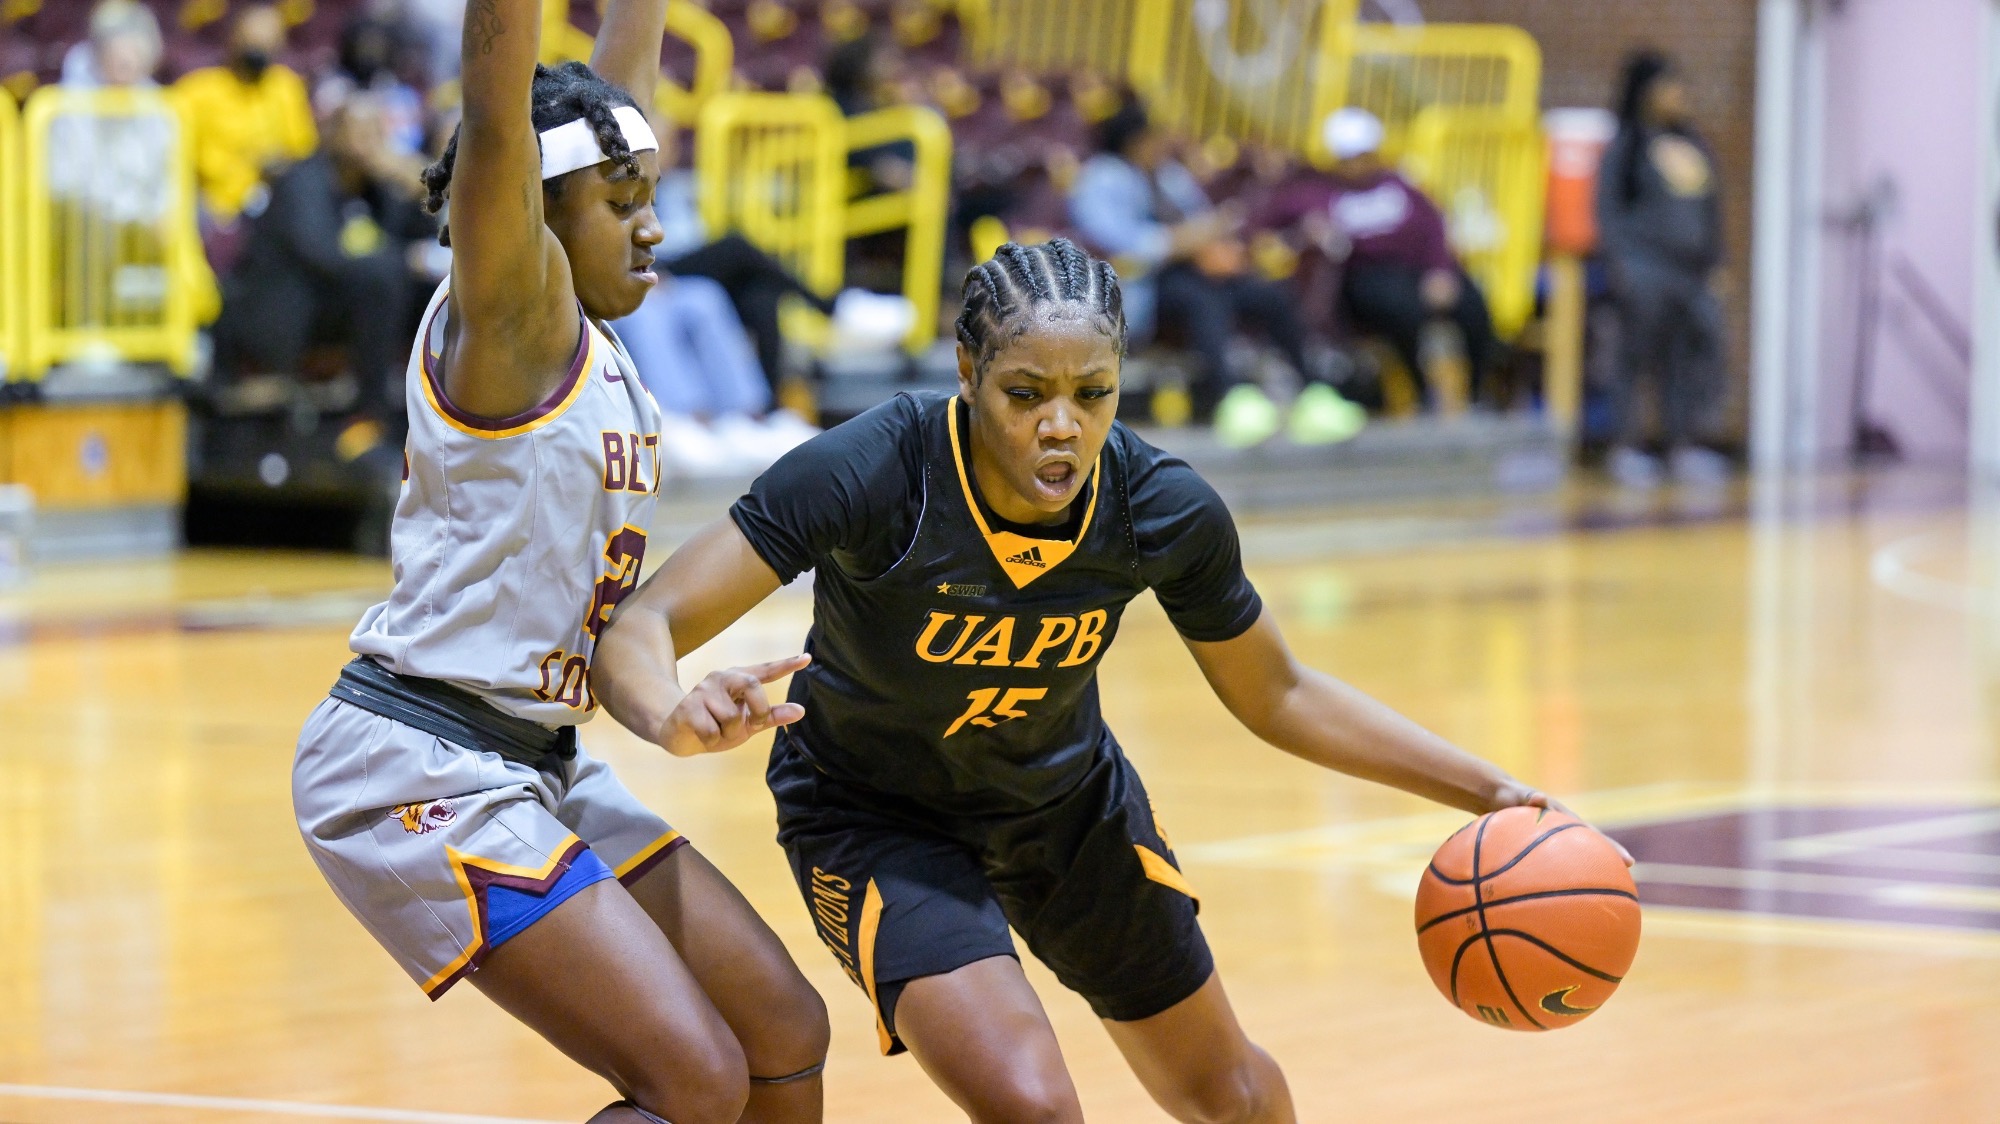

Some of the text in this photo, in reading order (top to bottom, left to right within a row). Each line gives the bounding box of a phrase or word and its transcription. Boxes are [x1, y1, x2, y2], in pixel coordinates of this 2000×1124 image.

[601, 430, 661, 498] BET
[1005, 556, 1047, 569] adidas
[949, 584, 987, 598] SWAC
[914, 608, 1108, 669] UAPB
[942, 687, 1049, 739] 15
[811, 866, 852, 946] LIONS
